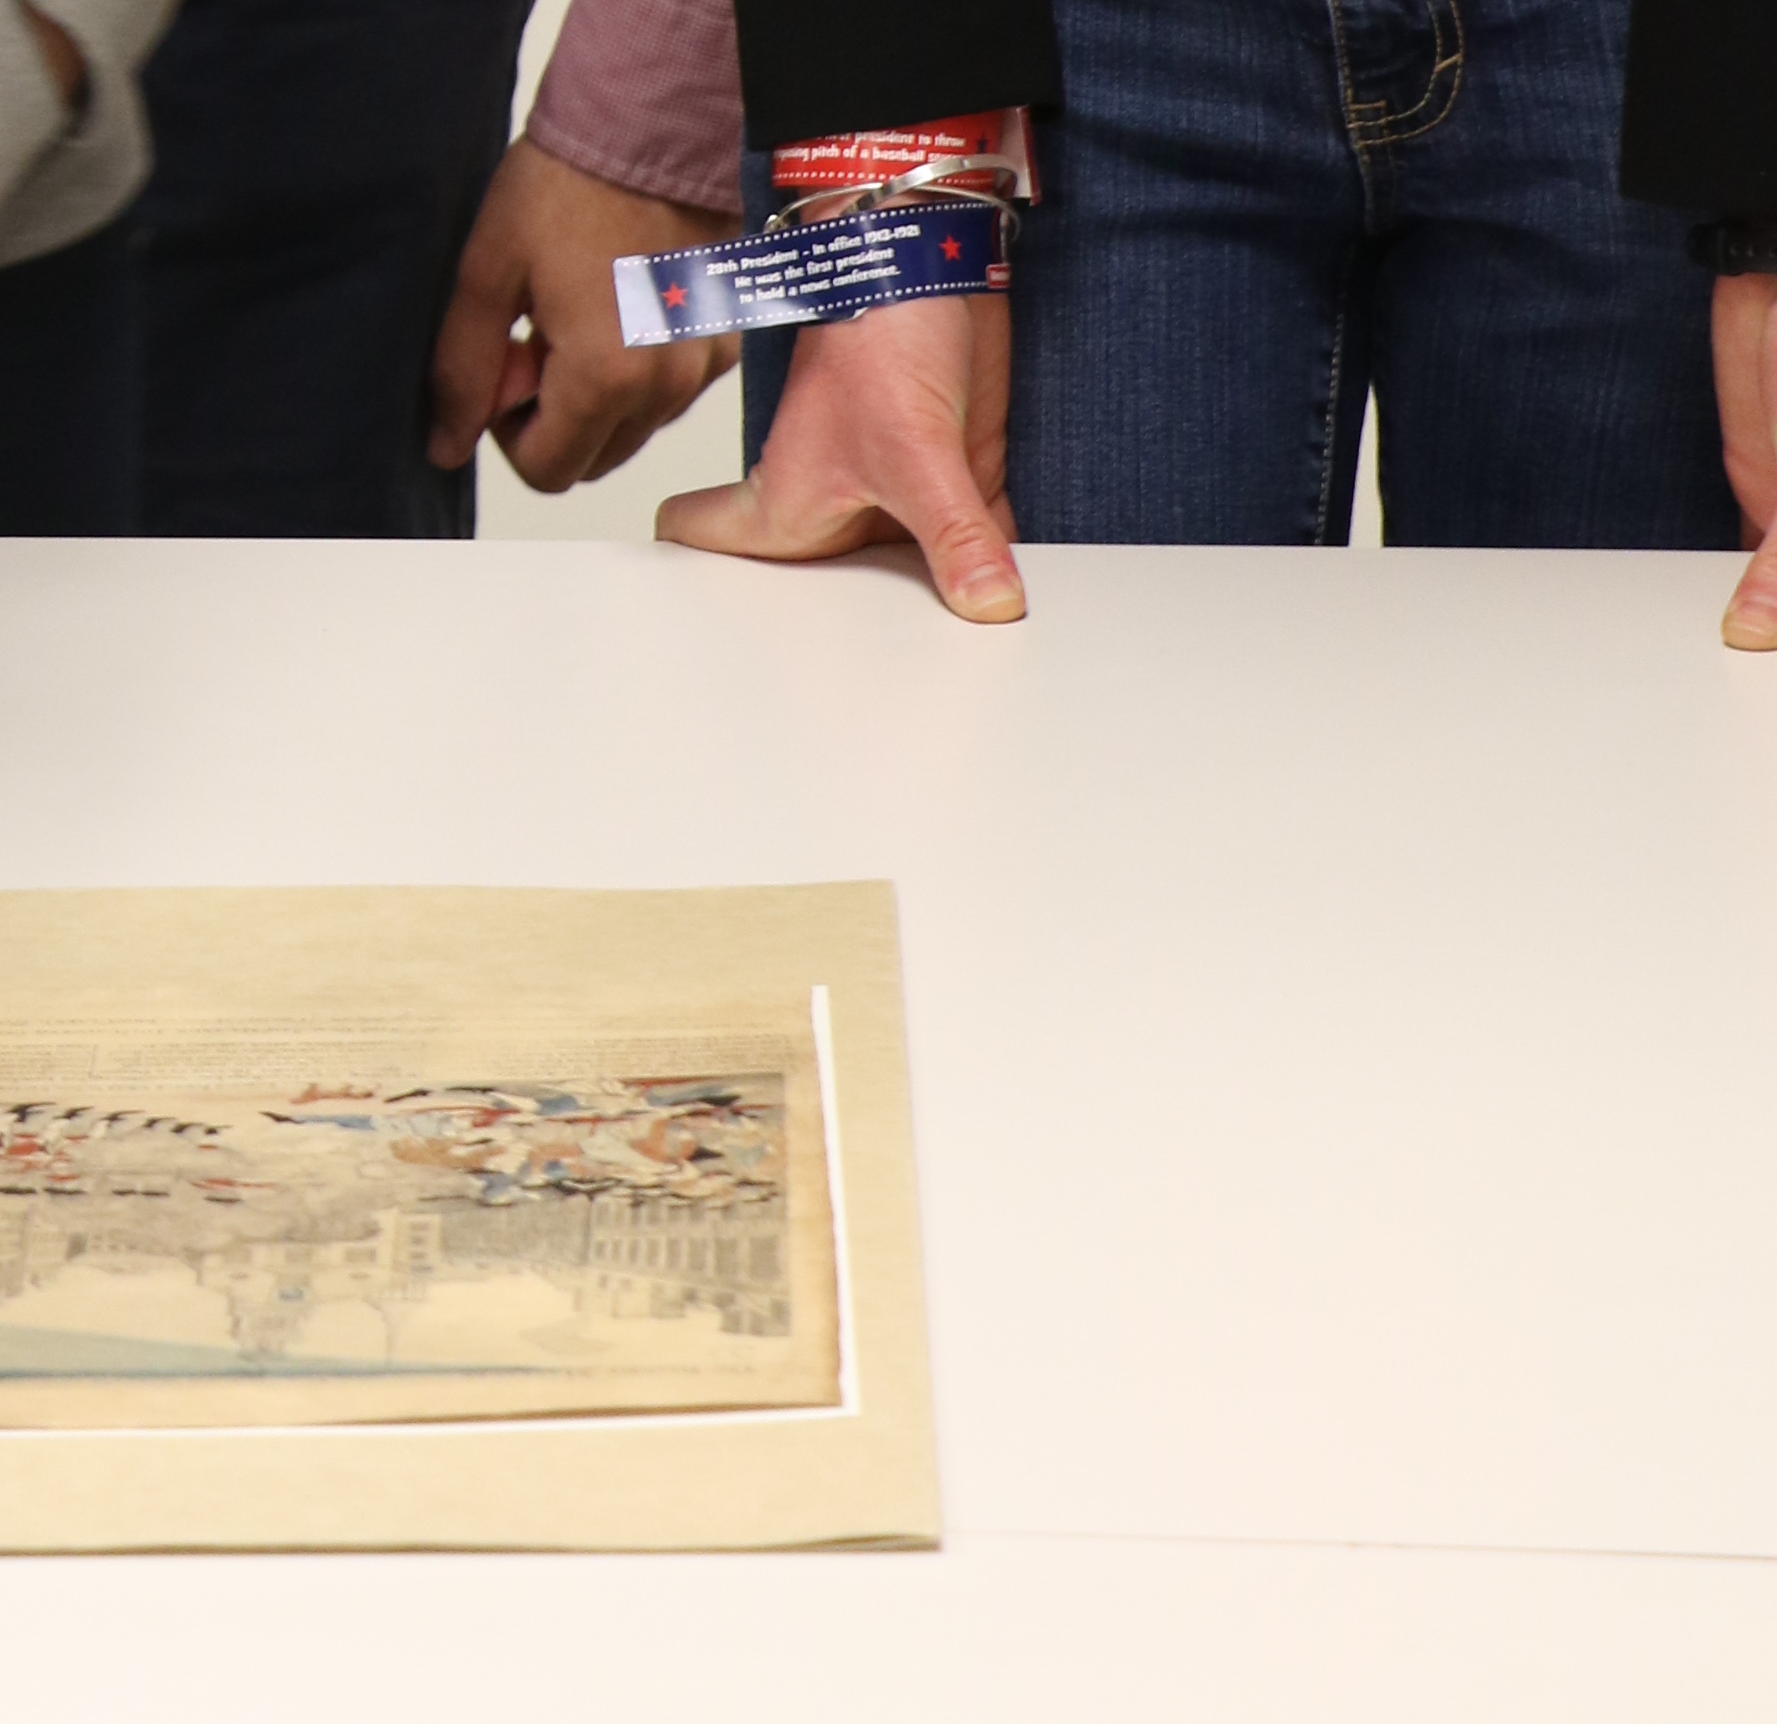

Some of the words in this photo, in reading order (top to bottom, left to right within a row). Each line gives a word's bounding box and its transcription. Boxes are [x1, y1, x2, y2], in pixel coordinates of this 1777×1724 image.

[810, 143, 841, 162] pitch
[842, 144, 858, 159] of
[859, 148, 870, 160] a
[872, 145, 926, 163] baseball
[917, 133, 933, 146] to
[734, 275, 753, 289] He
[754, 271, 783, 286] was
[784, 264, 805, 281] the
[806, 260, 835, 276] first
[835, 247, 895, 273] president
[740, 249, 800, 271] President
[827, 235, 863, 253] office
[739, 293, 754, 305] to
[755, 284, 786, 302] hold
[787, 286, 799, 297] a
[799, 279, 831, 295] news
[831, 264, 902, 287] conference.
